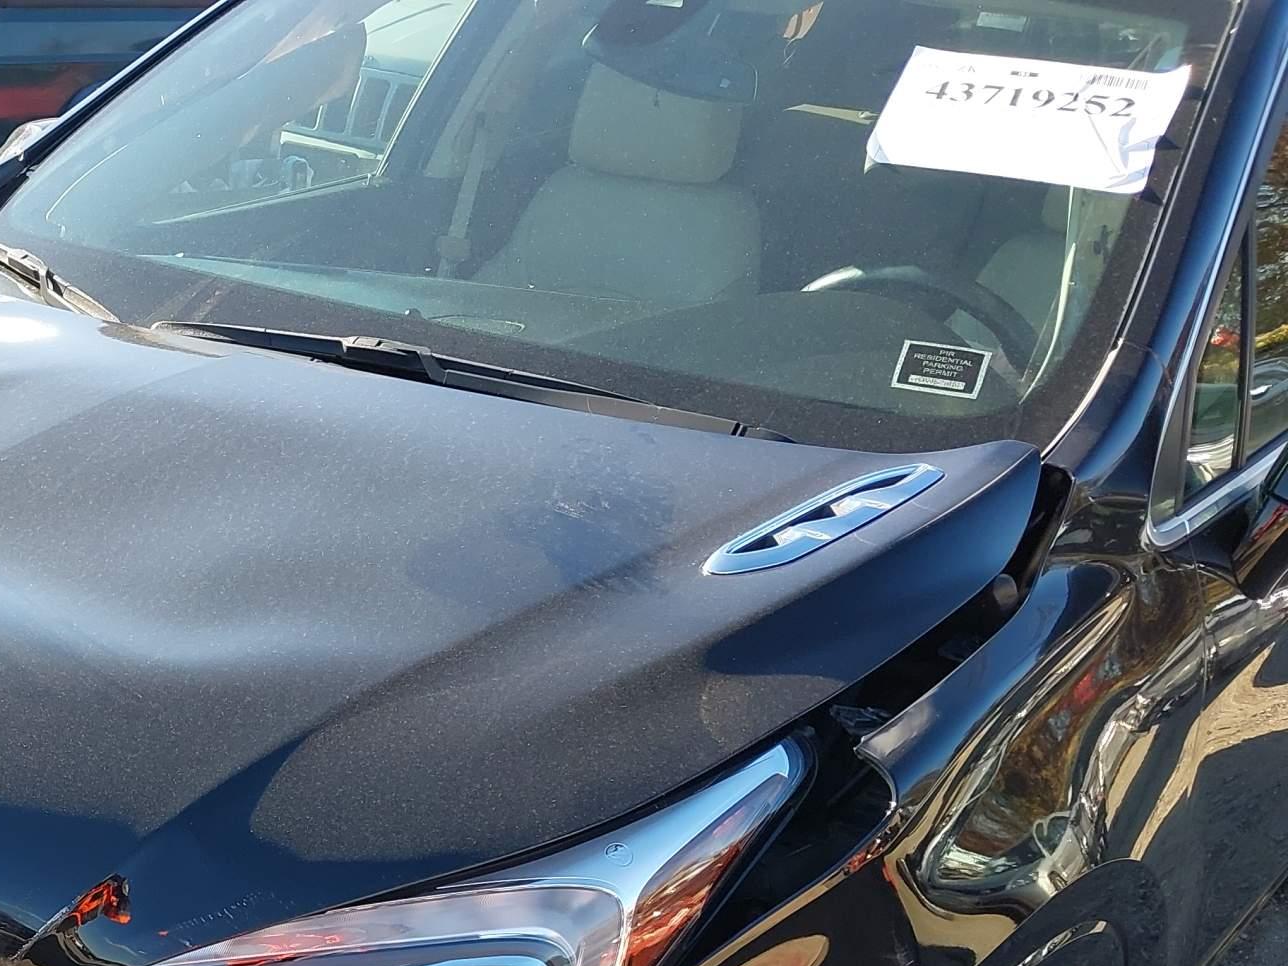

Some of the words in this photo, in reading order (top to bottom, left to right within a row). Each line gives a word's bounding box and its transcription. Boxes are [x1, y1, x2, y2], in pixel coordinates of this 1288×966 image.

[924, 79, 1137, 118] 43719252
[913, 353, 973, 366] RESIDENTIAL
[922, 361, 964, 372] PARKING
[922, 368, 958, 378] PERMIT
